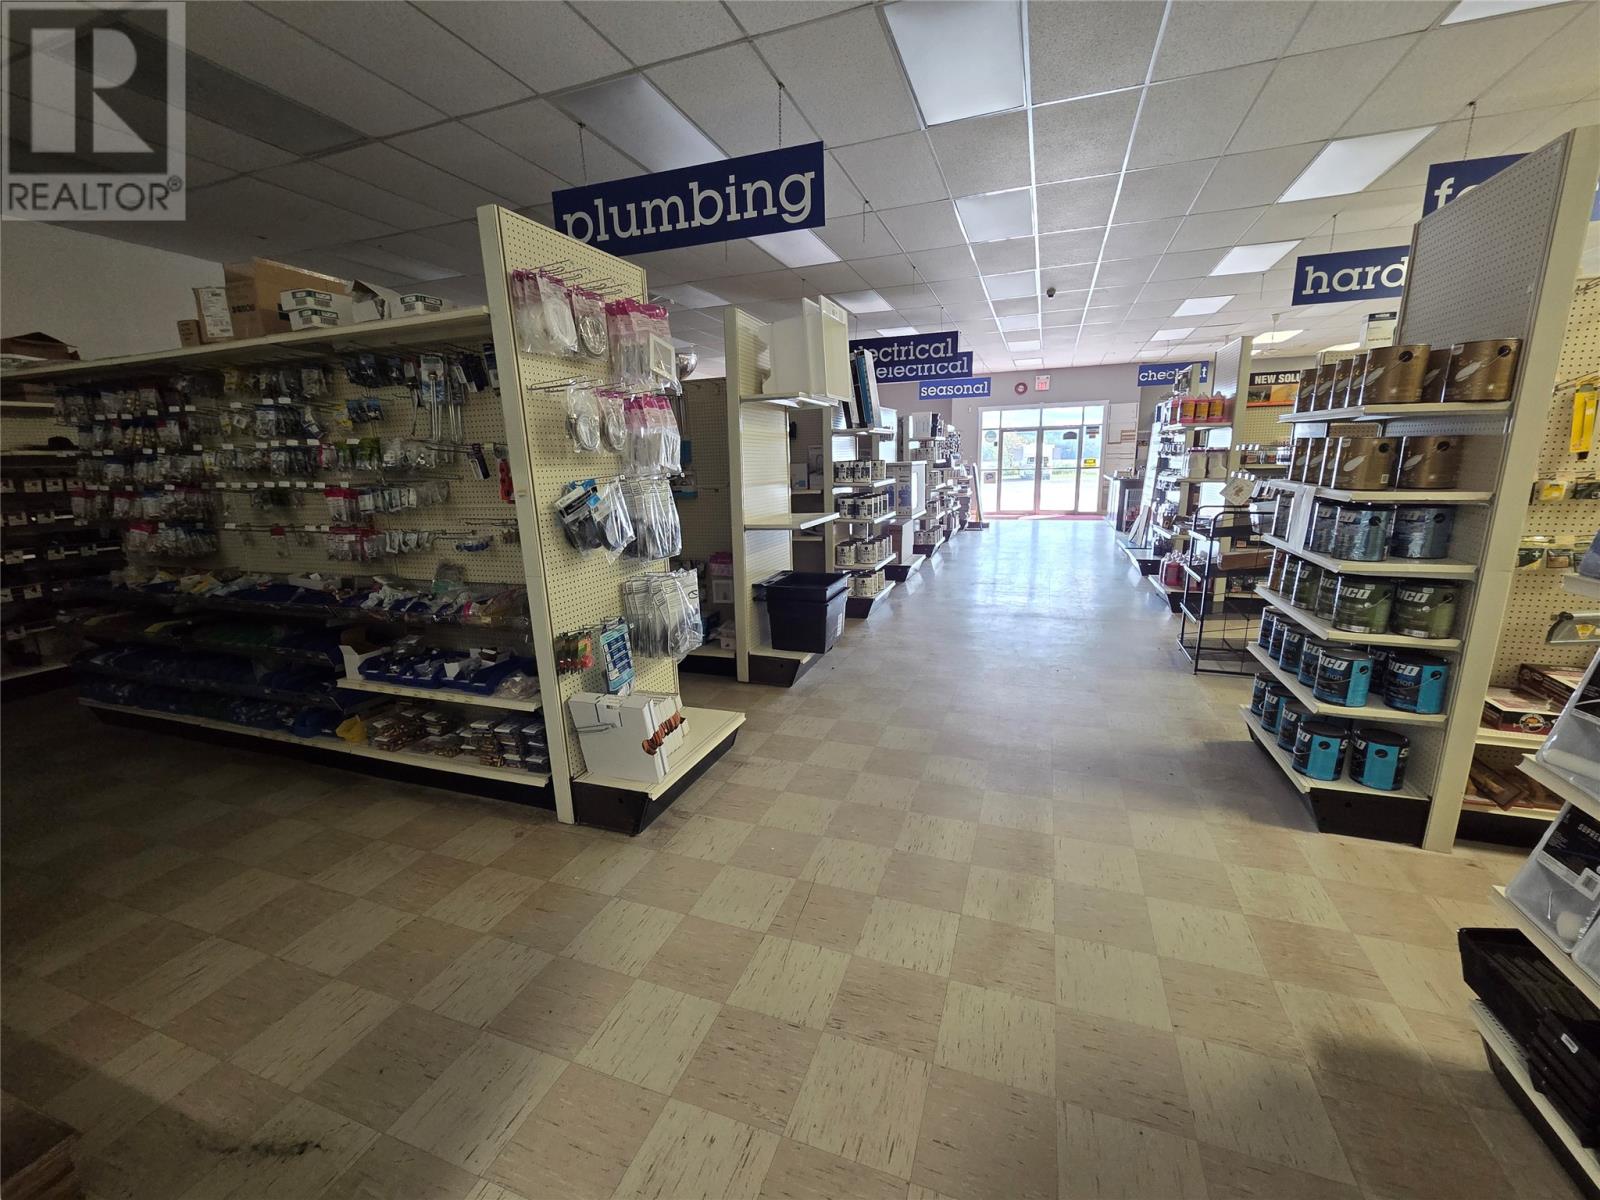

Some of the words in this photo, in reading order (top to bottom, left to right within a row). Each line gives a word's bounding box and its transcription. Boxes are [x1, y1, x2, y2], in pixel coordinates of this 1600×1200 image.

[563, 171, 815, 244] plumbing
[1254, 374, 1276, 385] NEW
[920, 382, 989, 397] seasonal
